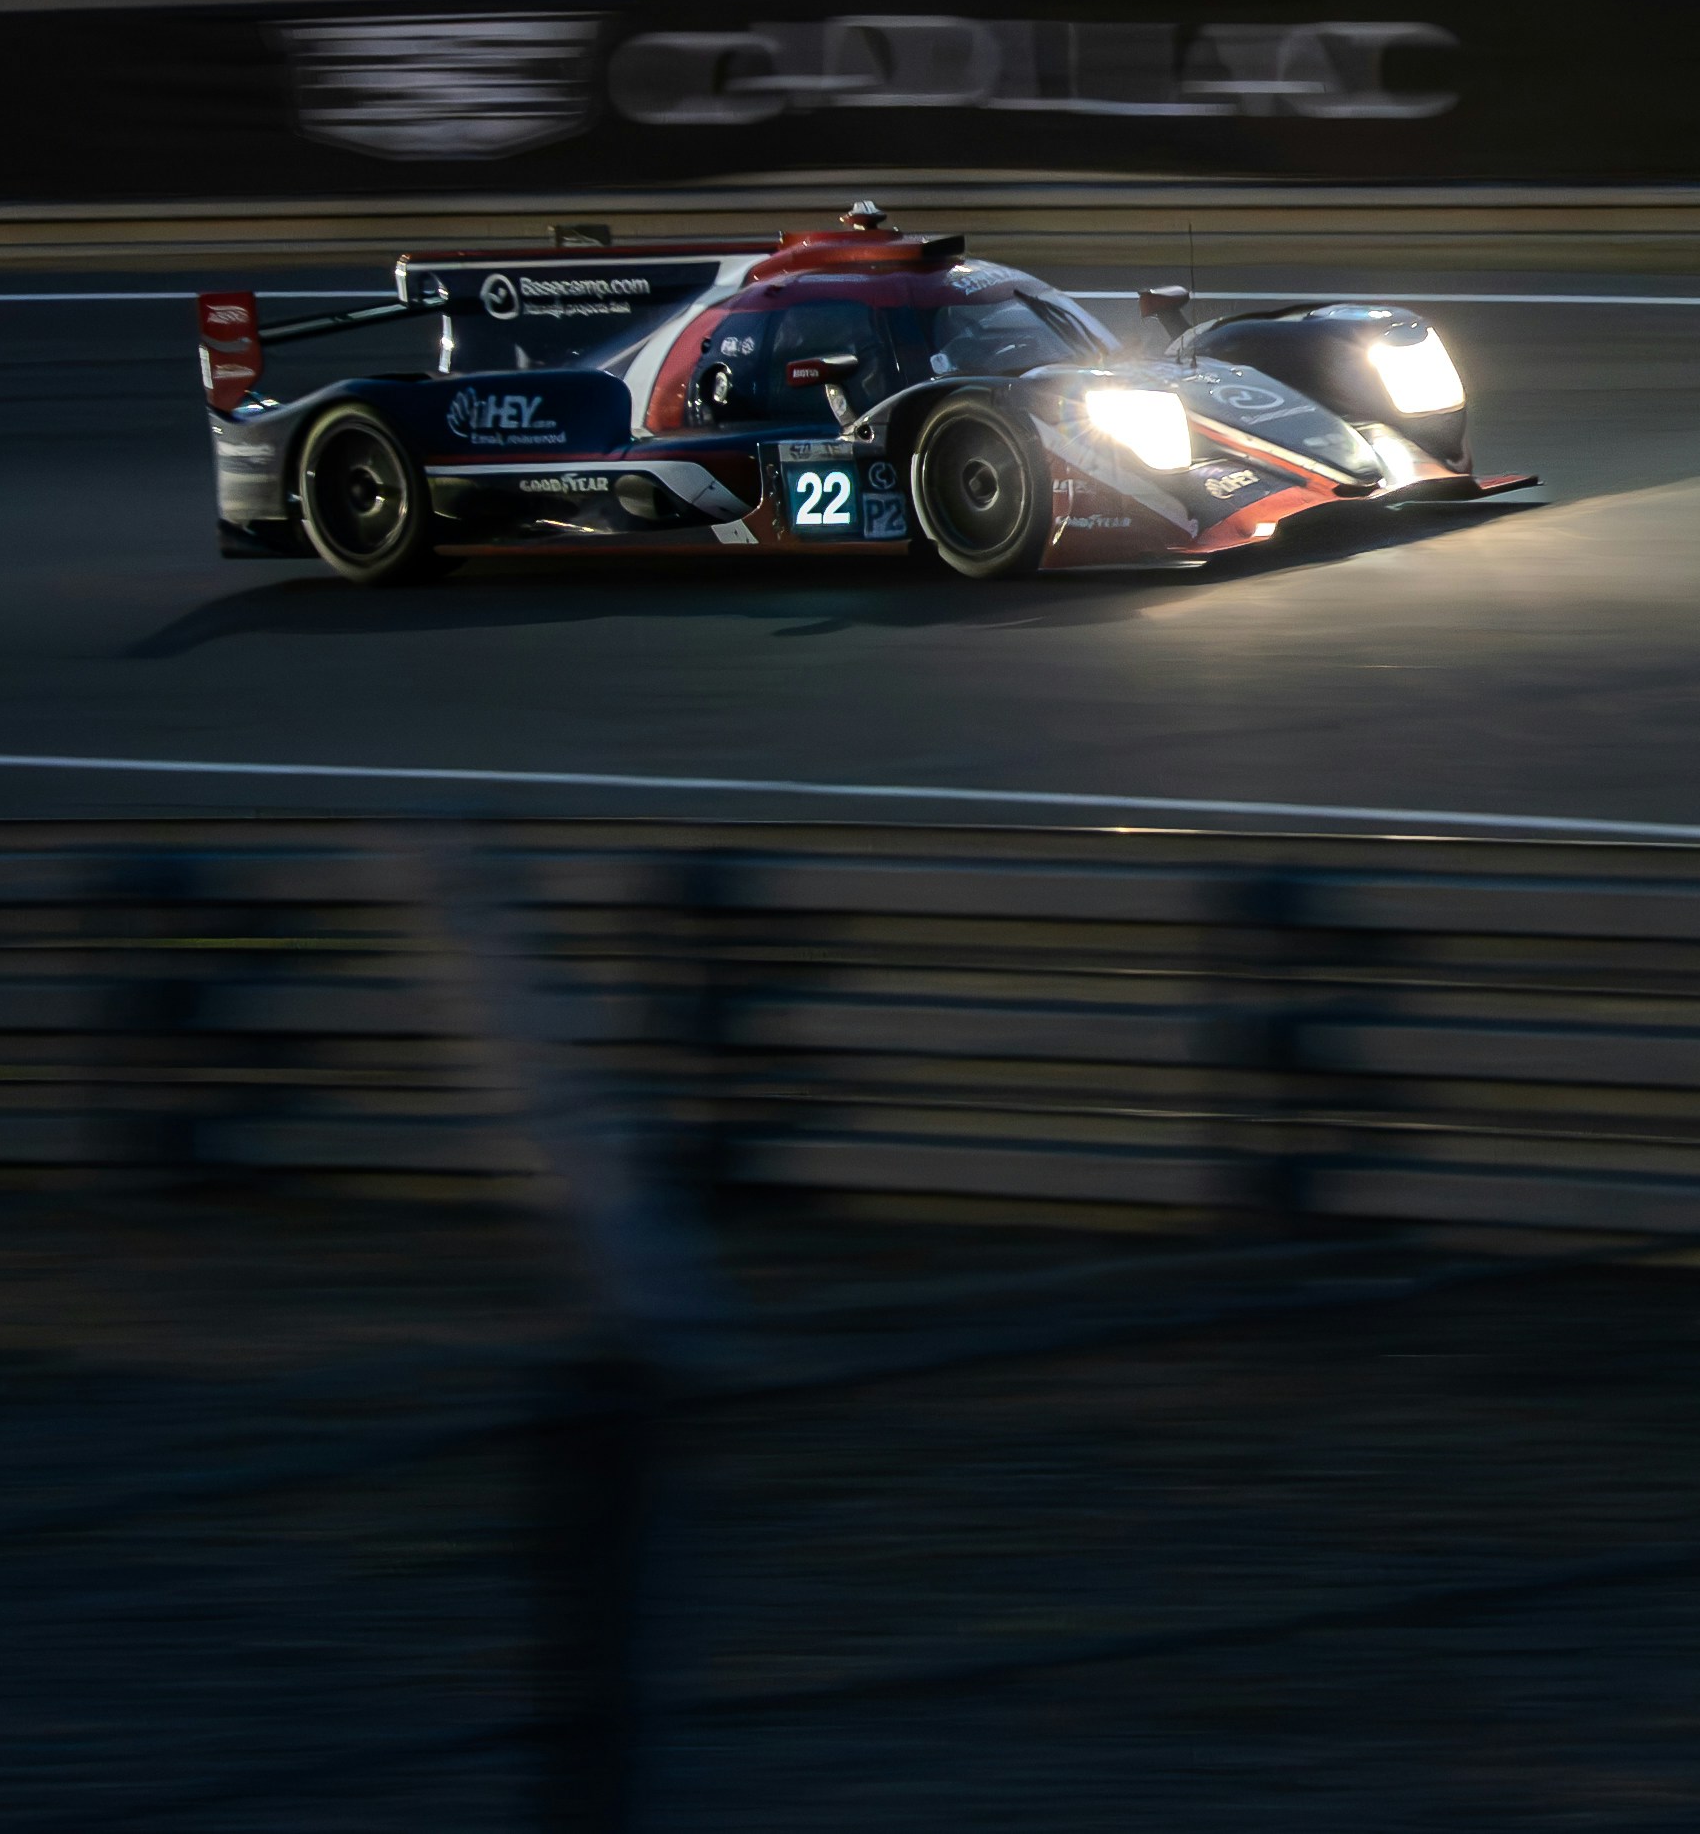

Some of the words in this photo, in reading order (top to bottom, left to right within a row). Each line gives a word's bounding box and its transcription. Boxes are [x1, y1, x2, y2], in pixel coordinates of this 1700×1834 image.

[608, 14, 1460, 125] CADILLAC
[520, 473, 608, 493] GOODYEAR
[796, 471, 850, 524] 22
